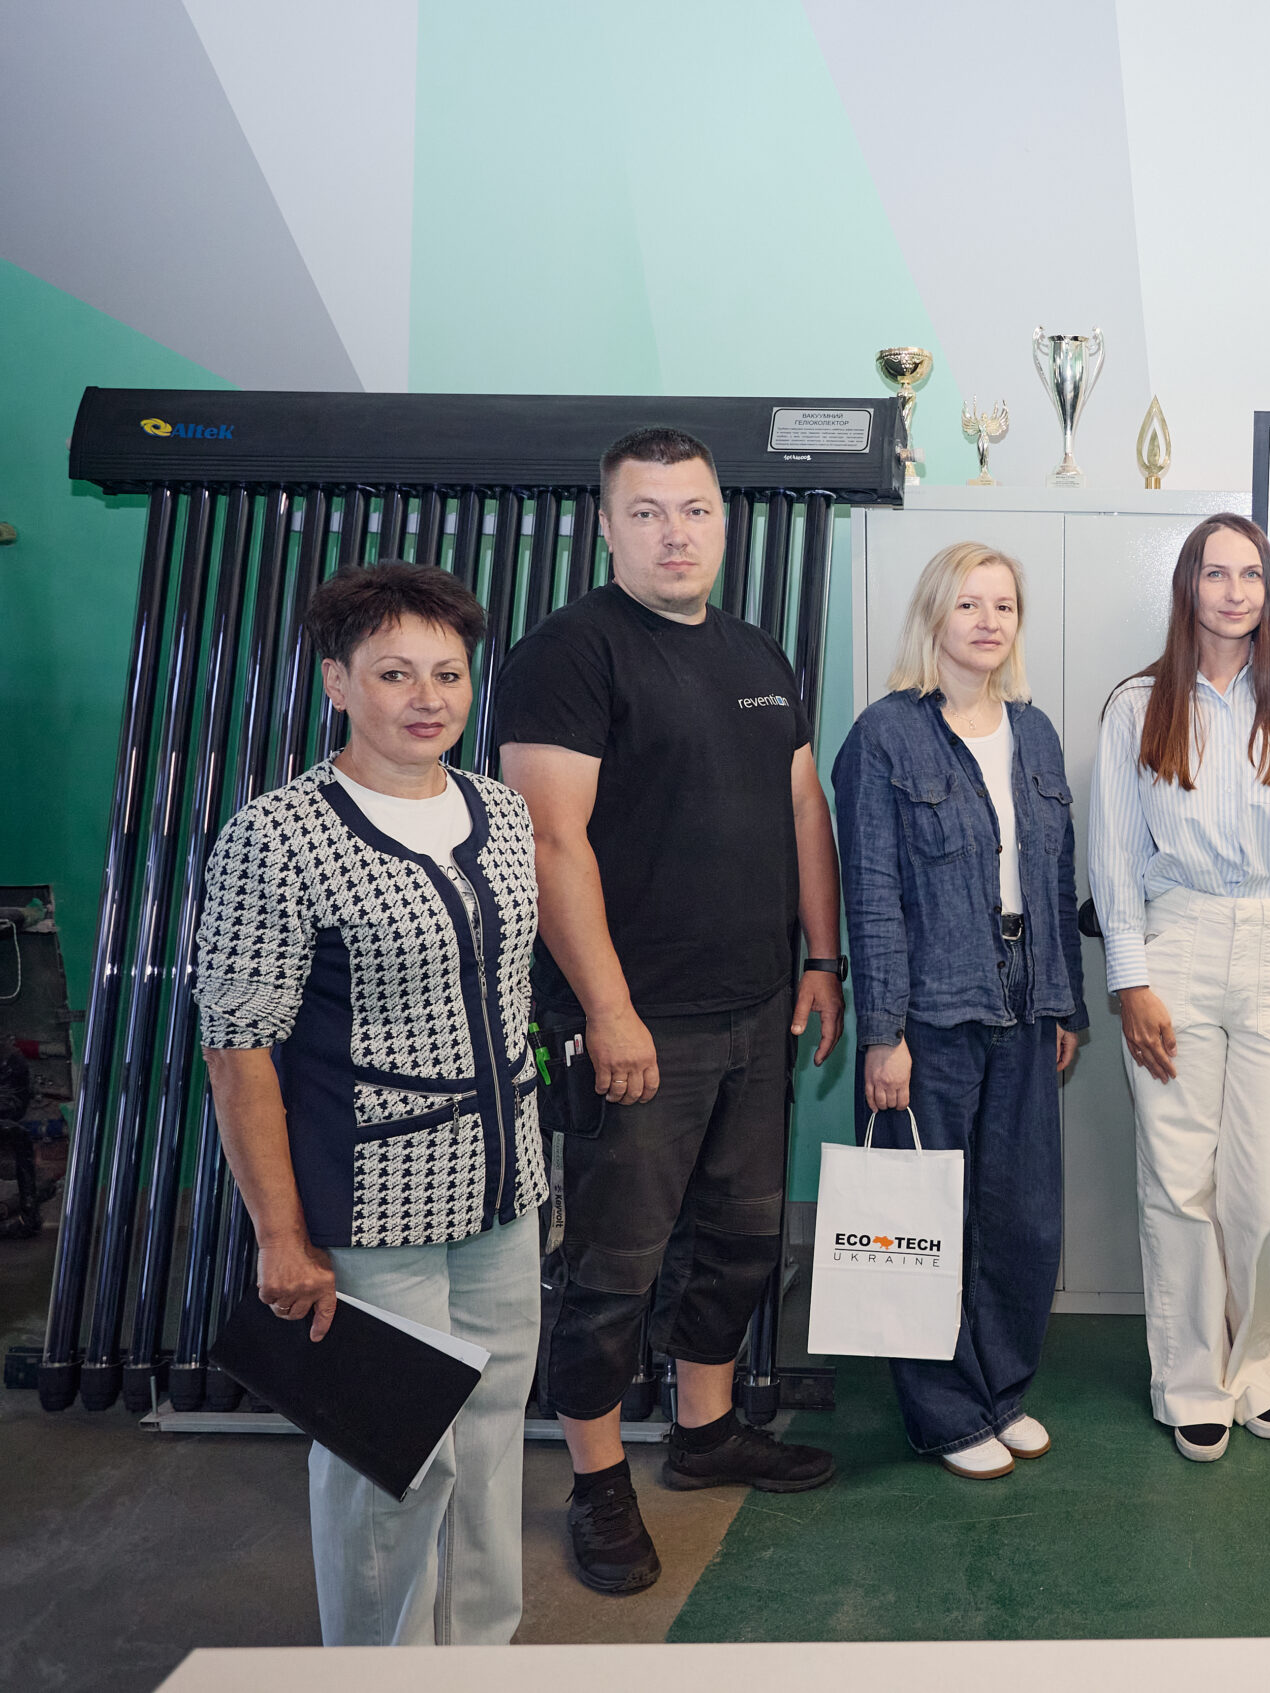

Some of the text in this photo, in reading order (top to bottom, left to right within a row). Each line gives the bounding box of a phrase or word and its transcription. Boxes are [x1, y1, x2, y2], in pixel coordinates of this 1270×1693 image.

[835, 1233, 941, 1252] ECO TECH
[833, 1252, 940, 1268] UKRAINE
